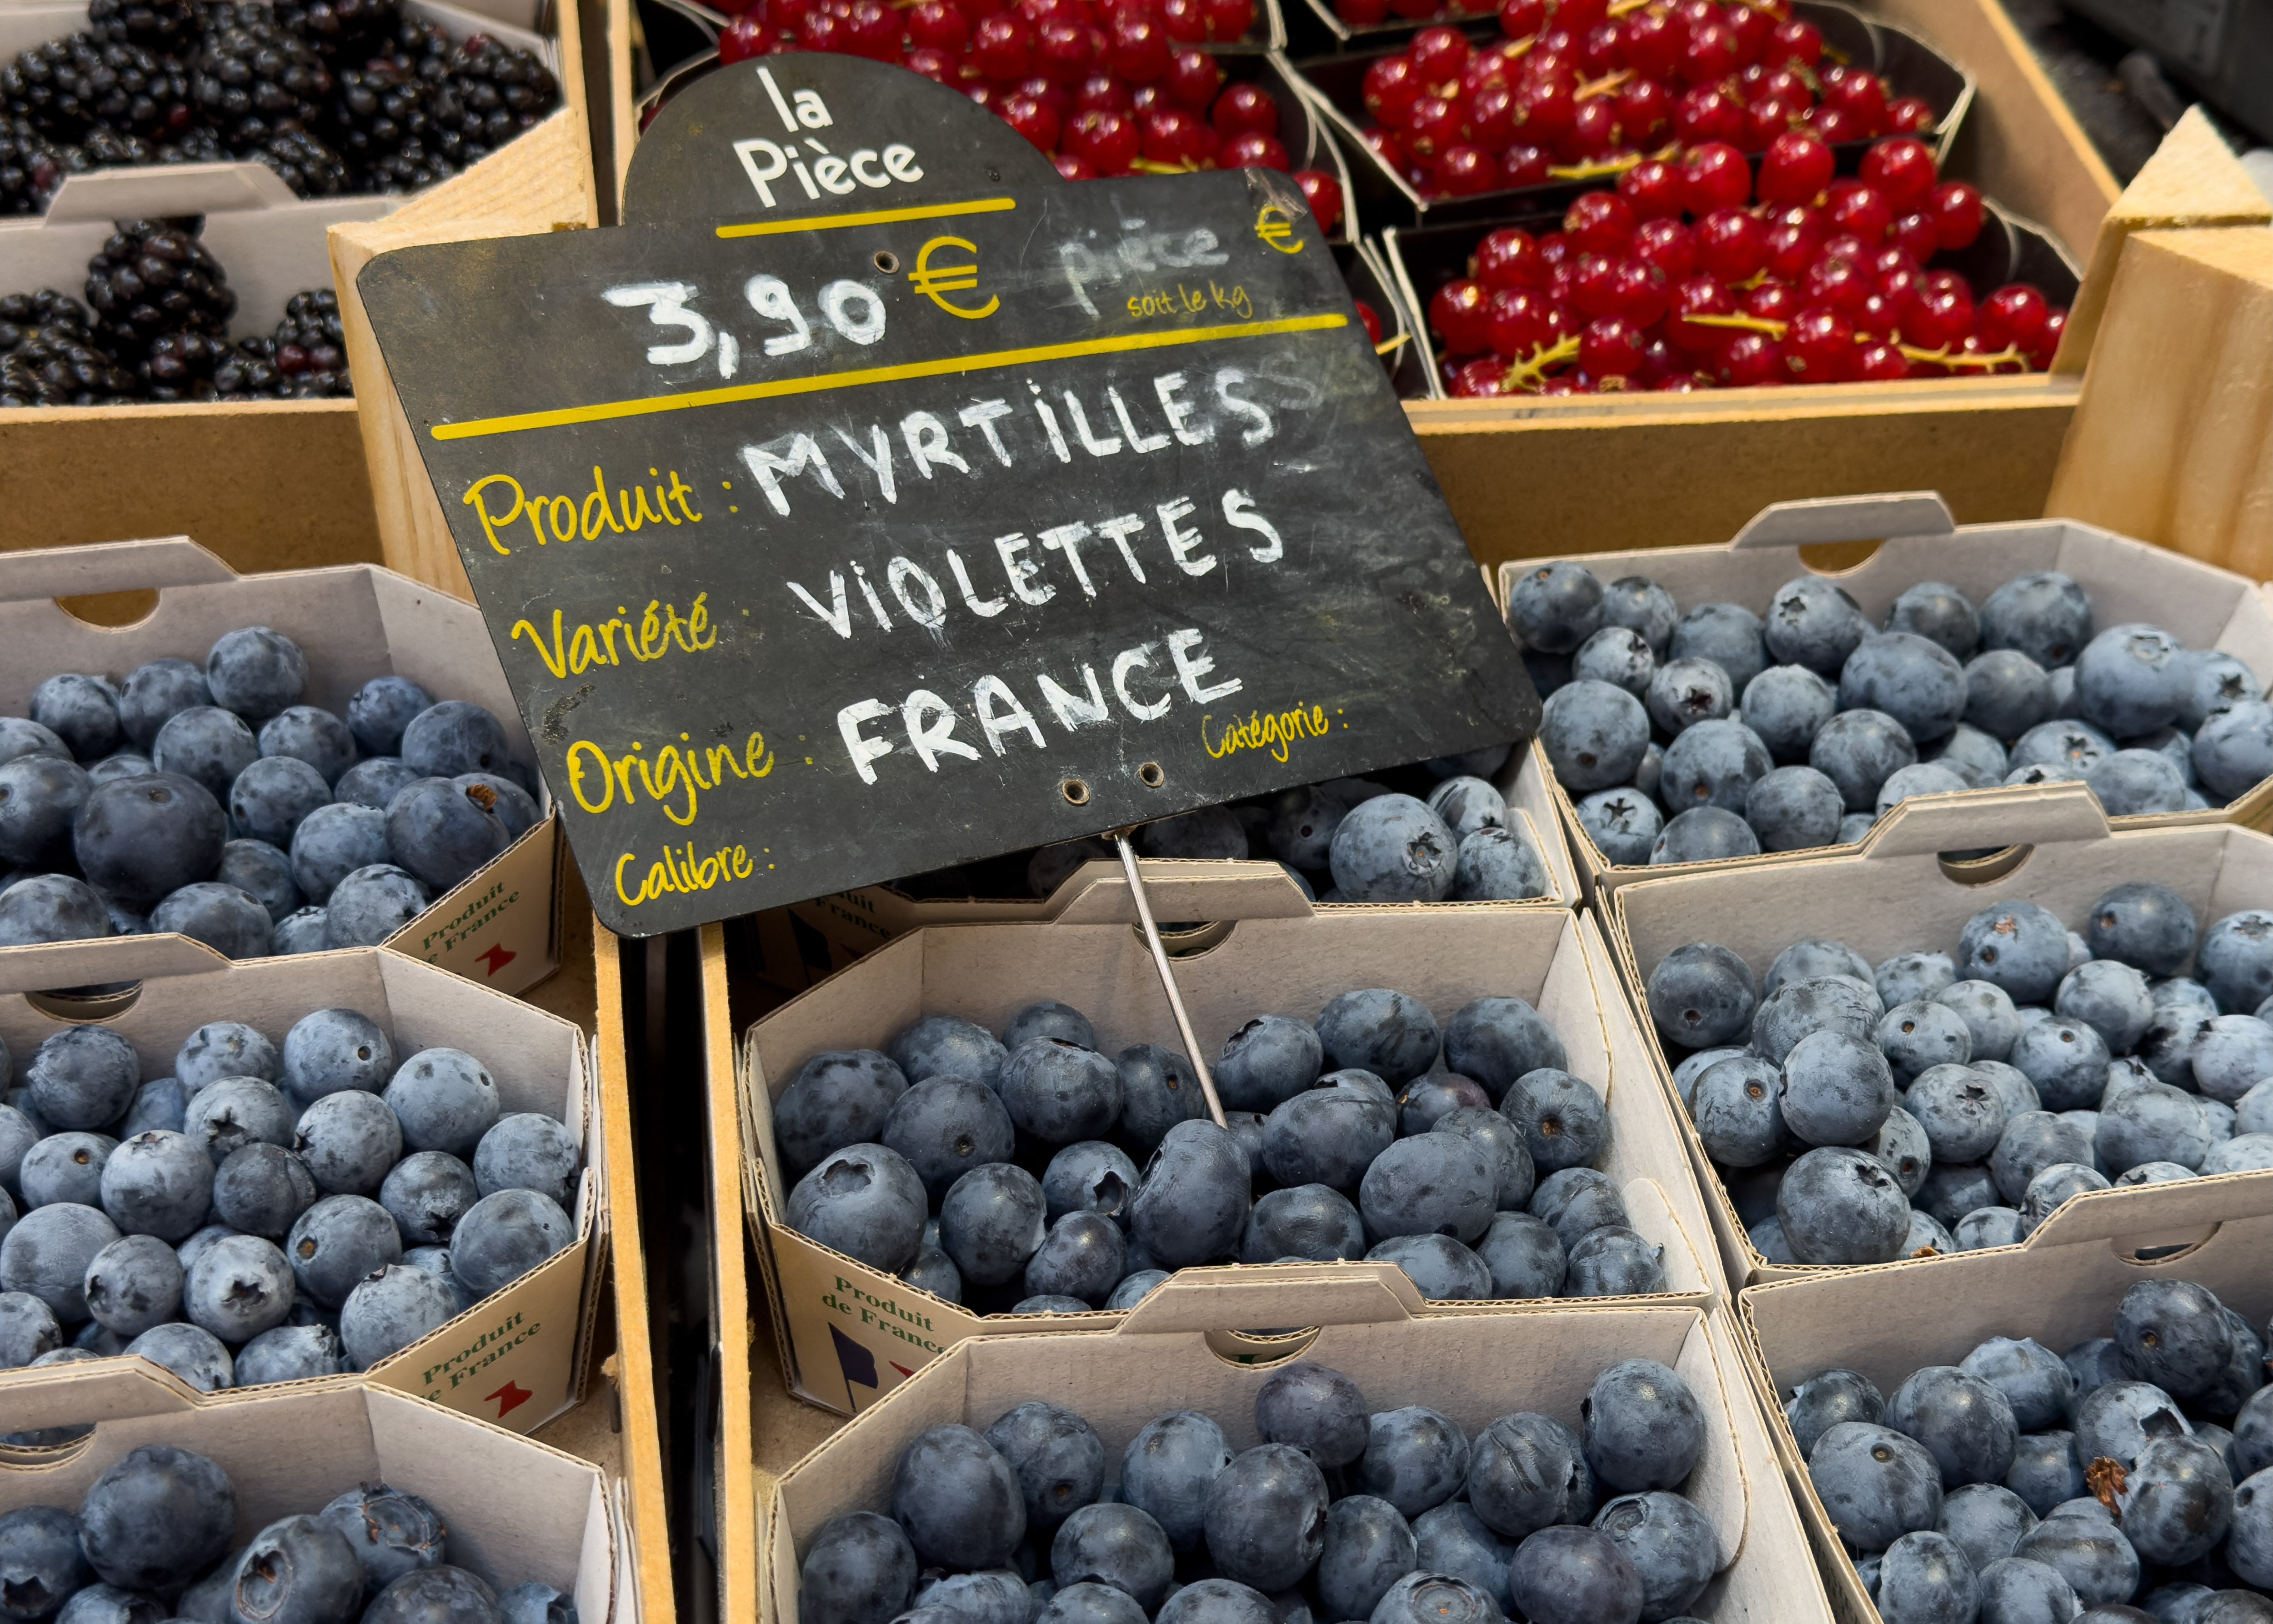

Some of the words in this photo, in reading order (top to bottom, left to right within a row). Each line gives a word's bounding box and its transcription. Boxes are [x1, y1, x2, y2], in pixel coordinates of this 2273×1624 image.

[756, 66, 833, 132] la
[732, 137, 924, 208] Pièce
[601, 274, 886, 380] 3,90
[909, 236, 1000, 319] €
[1255, 206, 1304, 254] €
[1127, 290, 1178, 318] soit
[1178, 283, 1207, 313] le
[1209, 280, 1253, 319] kg
[464, 466, 702, 555] Produit
[511, 592, 717, 679] Variété
[566, 732, 774, 826] Origine
[837, 628, 1243, 785] FRANCE
[1202, 702, 1328, 762] Catégorie
[616, 841, 753, 906] Calibre
[422, 882, 506, 951] Produit
[444, 891, 519, 952] France
[822, 1293, 852, 1315] de
[834, 1275, 934, 1331] Produit
[423, 1311, 525, 1385] Produit
[449, 1322, 541, 1390] France
